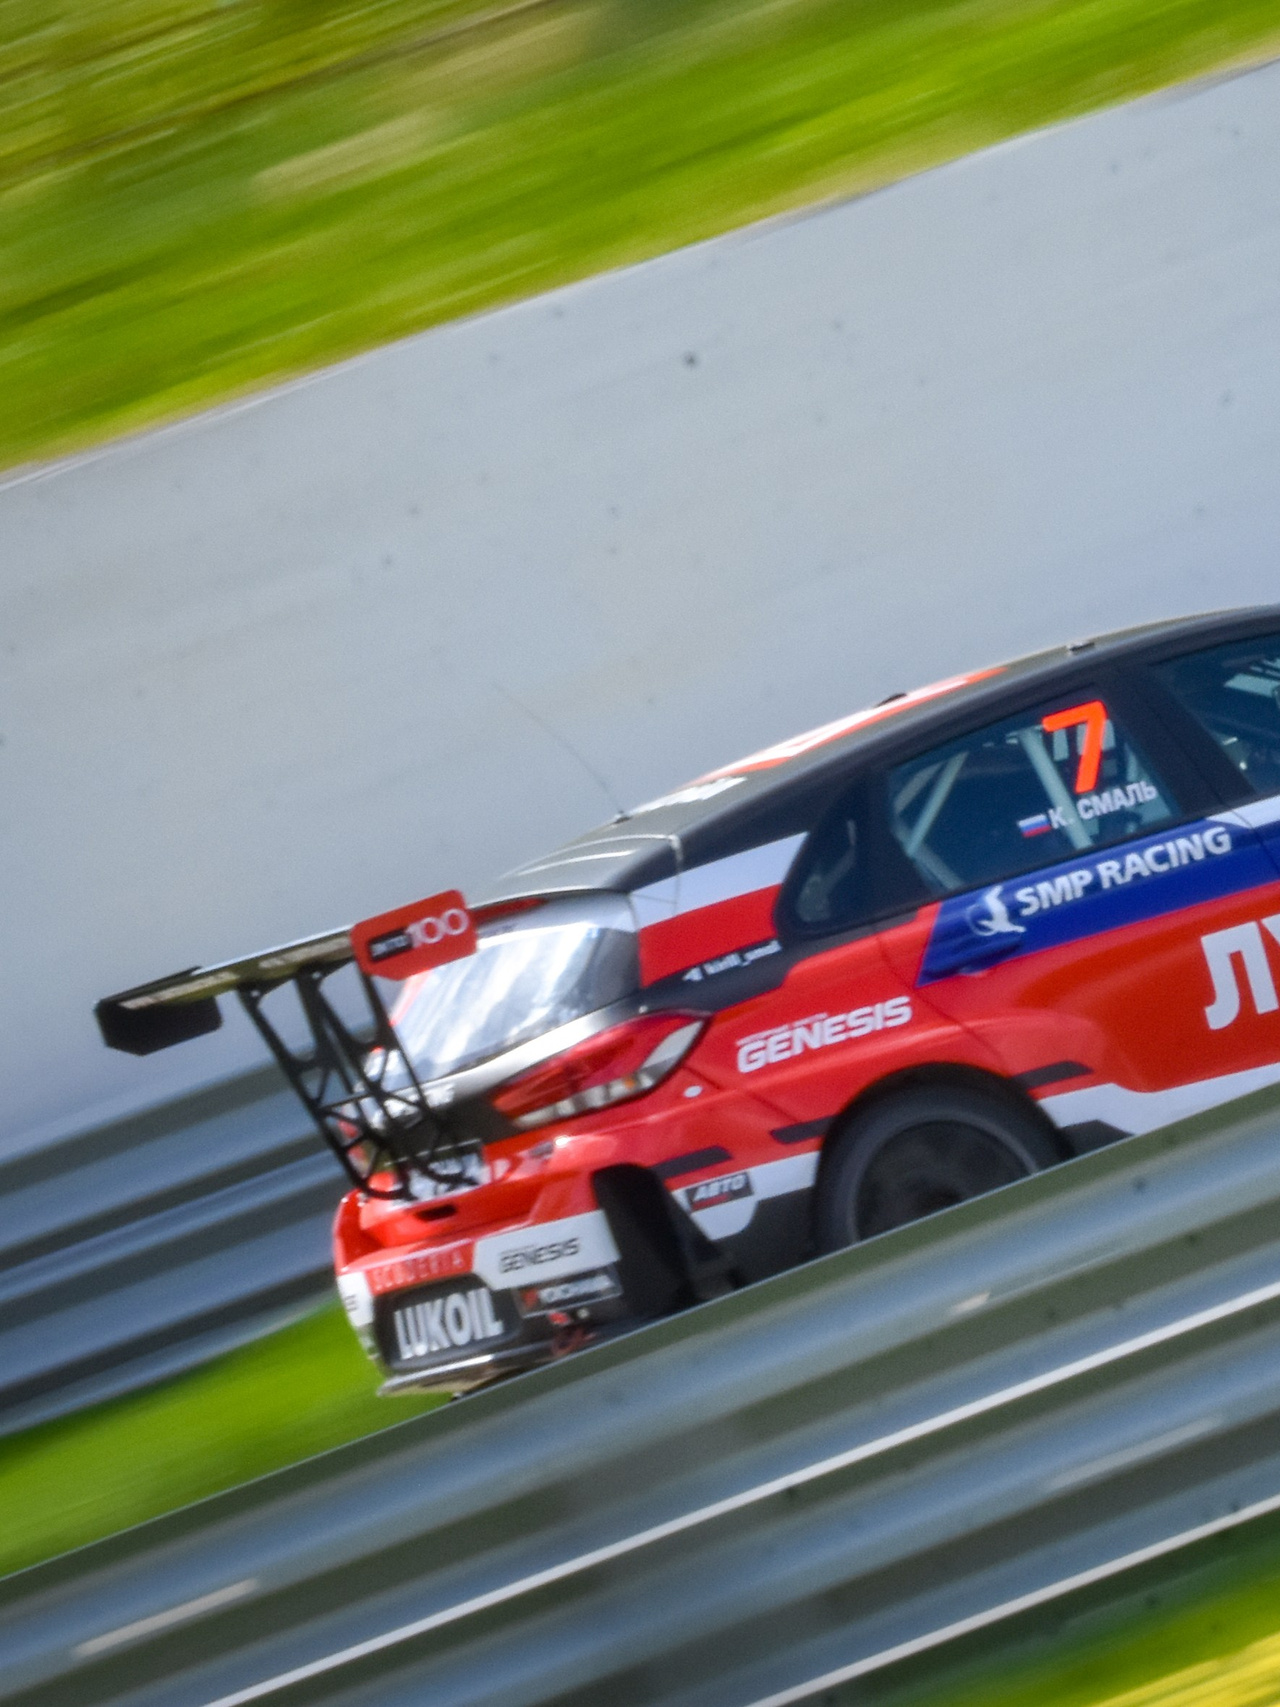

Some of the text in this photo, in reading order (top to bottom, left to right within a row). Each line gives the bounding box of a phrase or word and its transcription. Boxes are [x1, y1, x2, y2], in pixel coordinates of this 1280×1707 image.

[1041, 700, 1108, 795] 7
[1076, 780, 1158, 820] СМАЛЬ
[1015, 826, 1232, 916] SMP RACING
[736, 995, 913, 1073] GENESIS
[501, 1237, 581, 1273] GENESIS
[393, 1287, 504, 1361] LUKOIL
